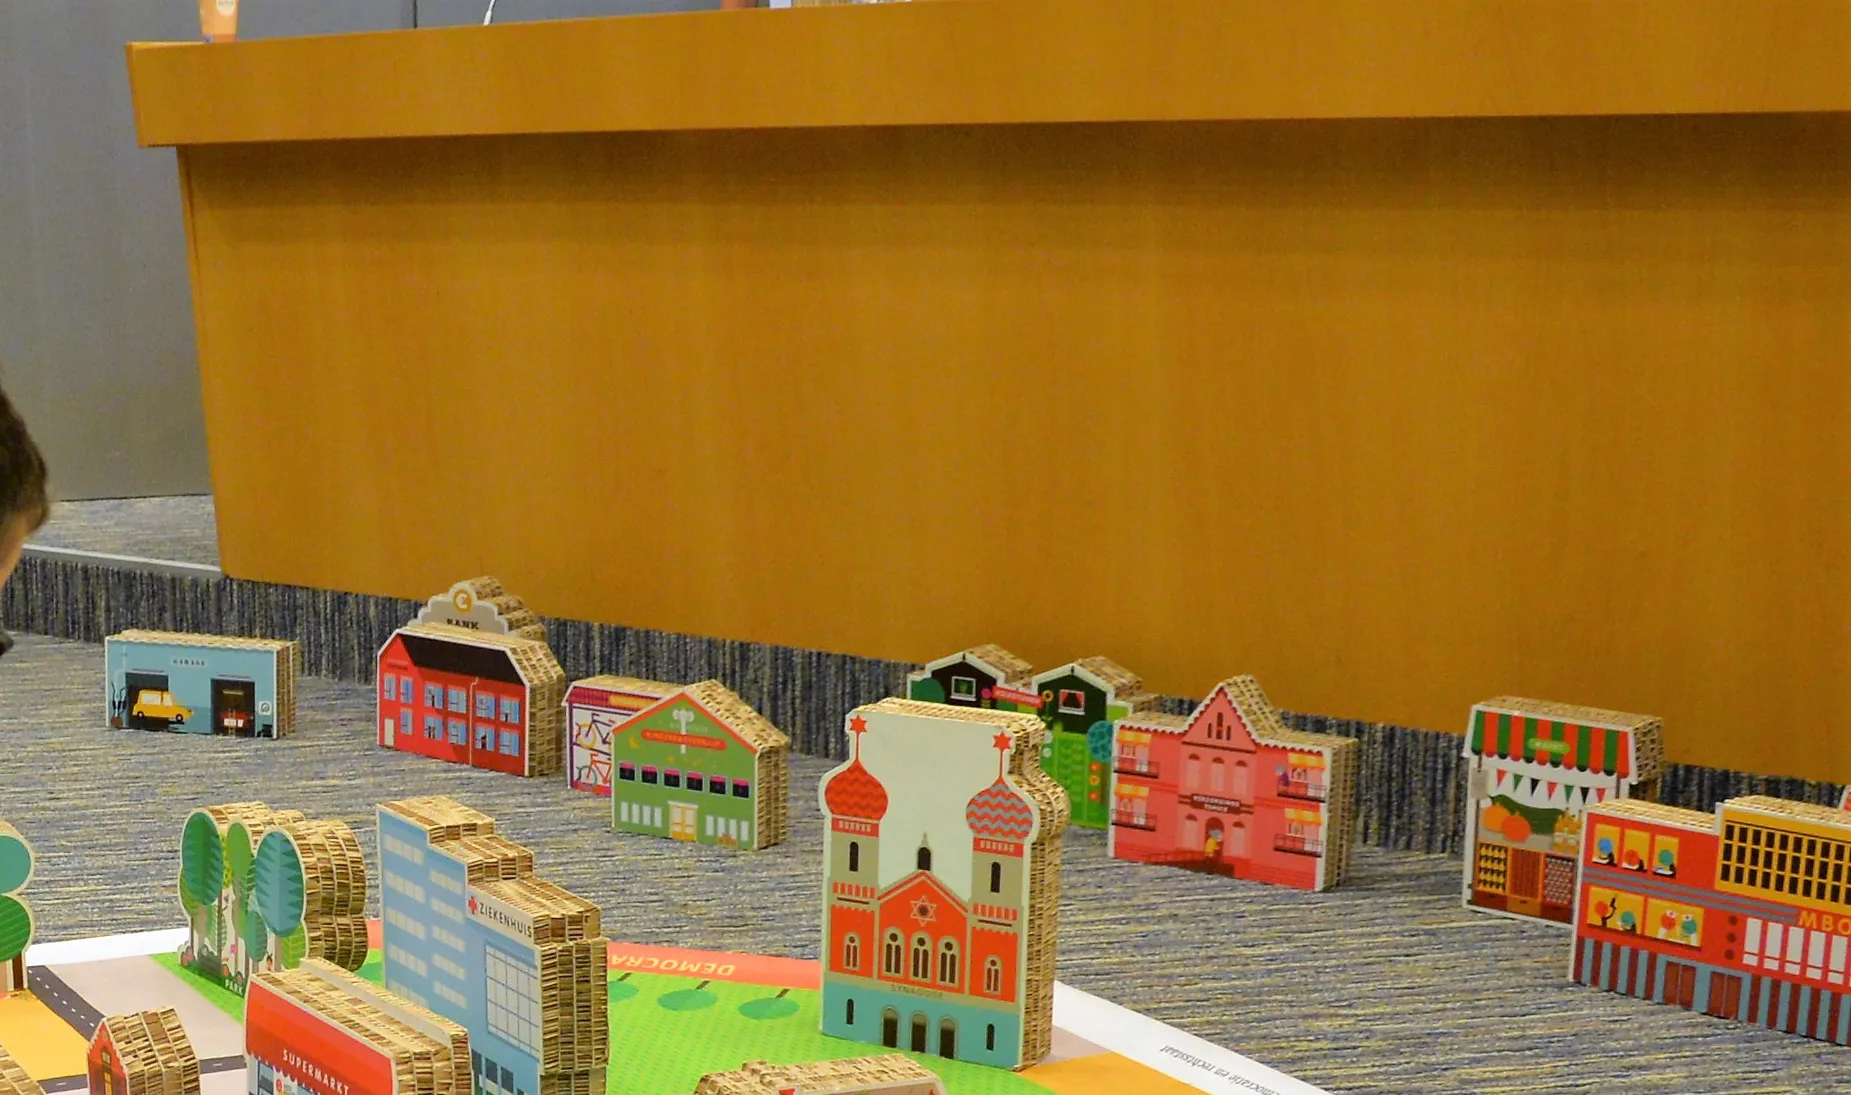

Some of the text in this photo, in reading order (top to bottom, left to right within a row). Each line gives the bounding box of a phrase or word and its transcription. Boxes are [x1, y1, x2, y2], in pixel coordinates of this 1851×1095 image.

[479, 902, 532, 938] ZIEKENHUIS
[1799, 910, 1851, 936] MBO
[1160, 1045, 1216, 1072] rechtsstaat
[1214, 1067, 1230, 1078] en
